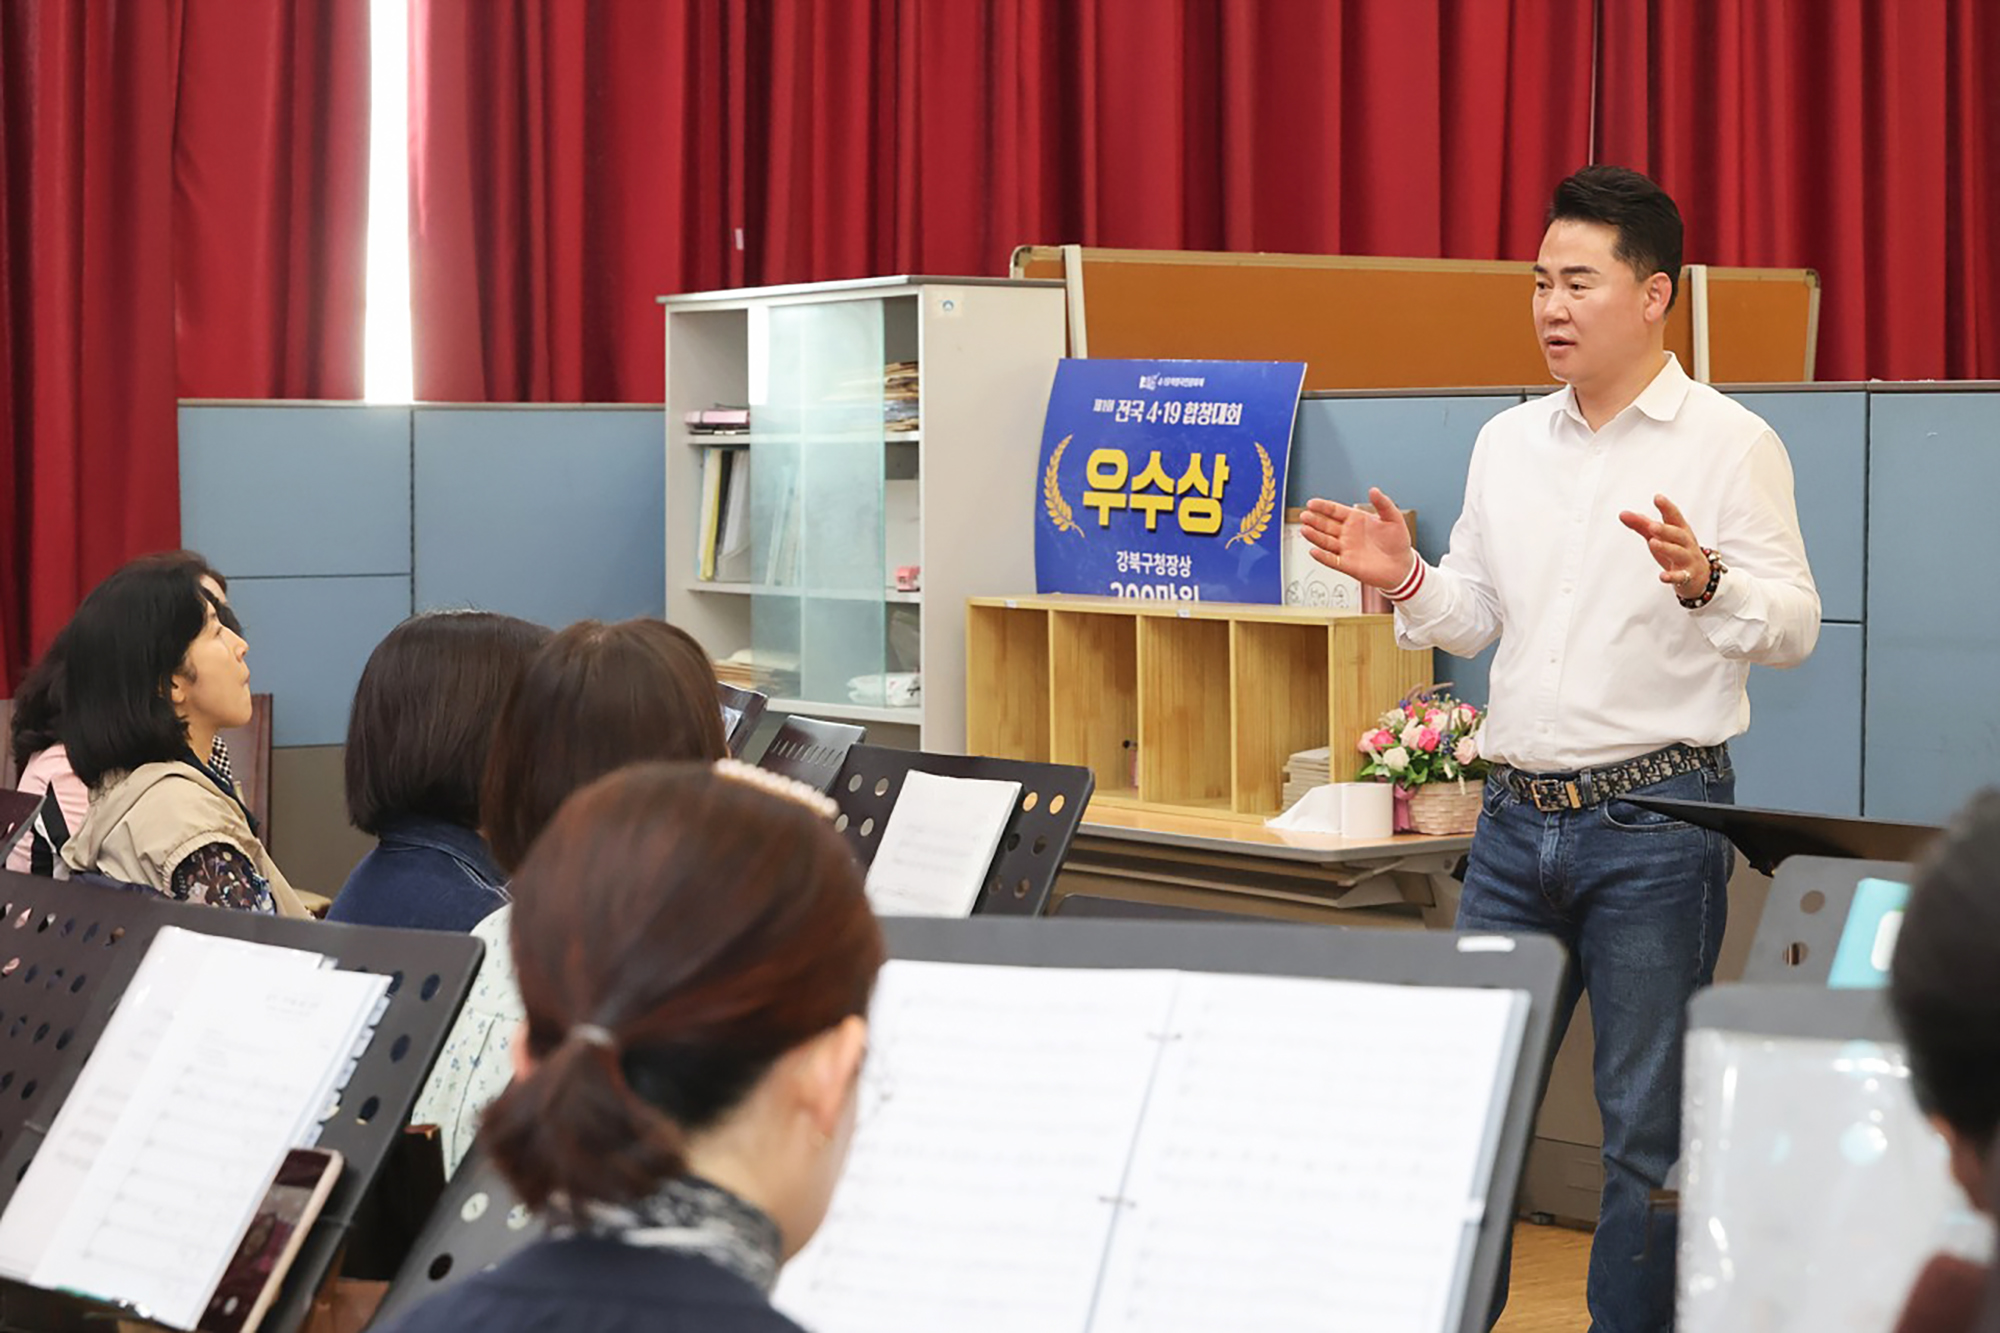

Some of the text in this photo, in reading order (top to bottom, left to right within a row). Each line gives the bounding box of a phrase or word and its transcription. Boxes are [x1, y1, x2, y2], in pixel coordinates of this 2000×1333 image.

[1115, 399, 1145, 423] 전국
[1182, 401, 1244, 426] 합창대회
[1082, 448, 1230, 535] 우수상
[1116, 550, 1193, 578] 강북구청장상
